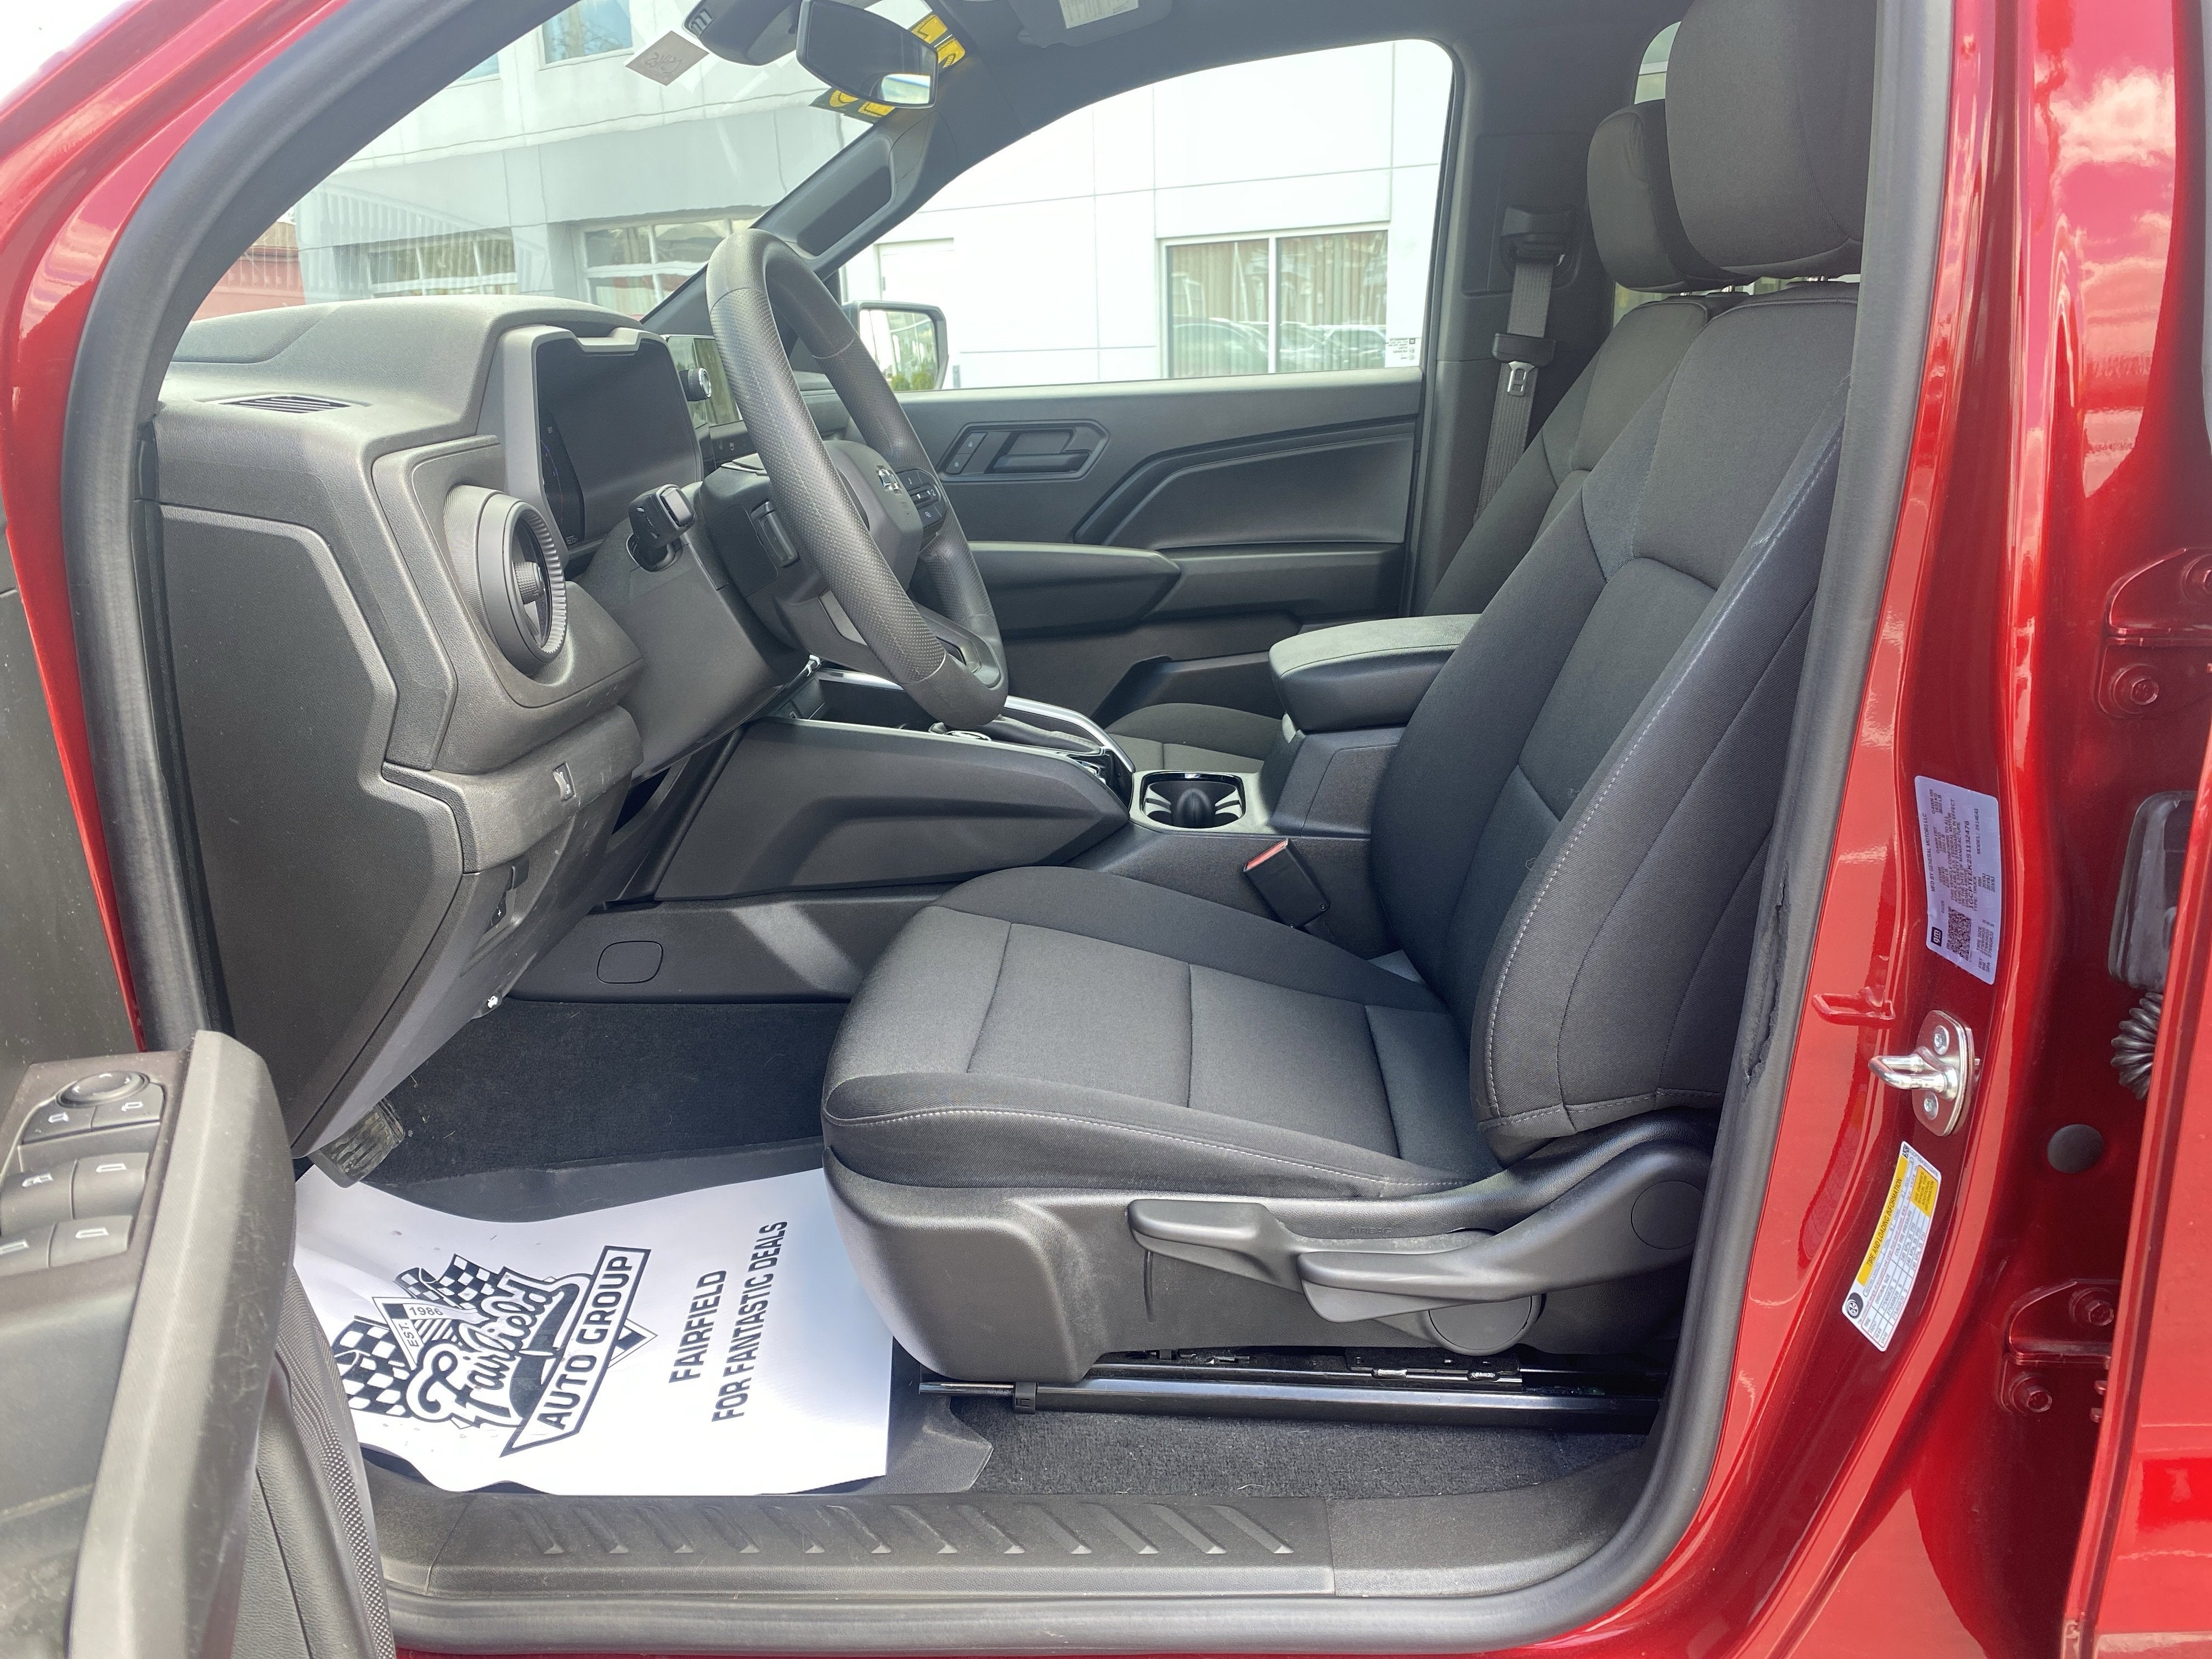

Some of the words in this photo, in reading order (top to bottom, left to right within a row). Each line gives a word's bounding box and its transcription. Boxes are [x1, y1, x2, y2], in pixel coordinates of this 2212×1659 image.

[747, 1221, 788, 1273] DEALS
[1349, 1227, 1392, 1236] AIRBAG
[1867, 1253, 1876, 1267] TIRE
[1872, 1241, 1881, 1254] AND
[1878, 1216, 1889, 1242] LOADING
[1887, 1177, 1902, 1216] INFORMATION
[394, 1322, 419, 1348] EST.
[409, 1305, 443, 1316] 1986
[537, 1355, 597, 1430] AUTO
[576, 1256, 633, 1345] GROUP
[668, 1270, 727, 1383] FAIRFIELD
[723, 1273, 774, 1378] FANTASTIC
[409, 1269, 551, 1424] Fairfield
[711, 1377, 752, 1422] FOR
